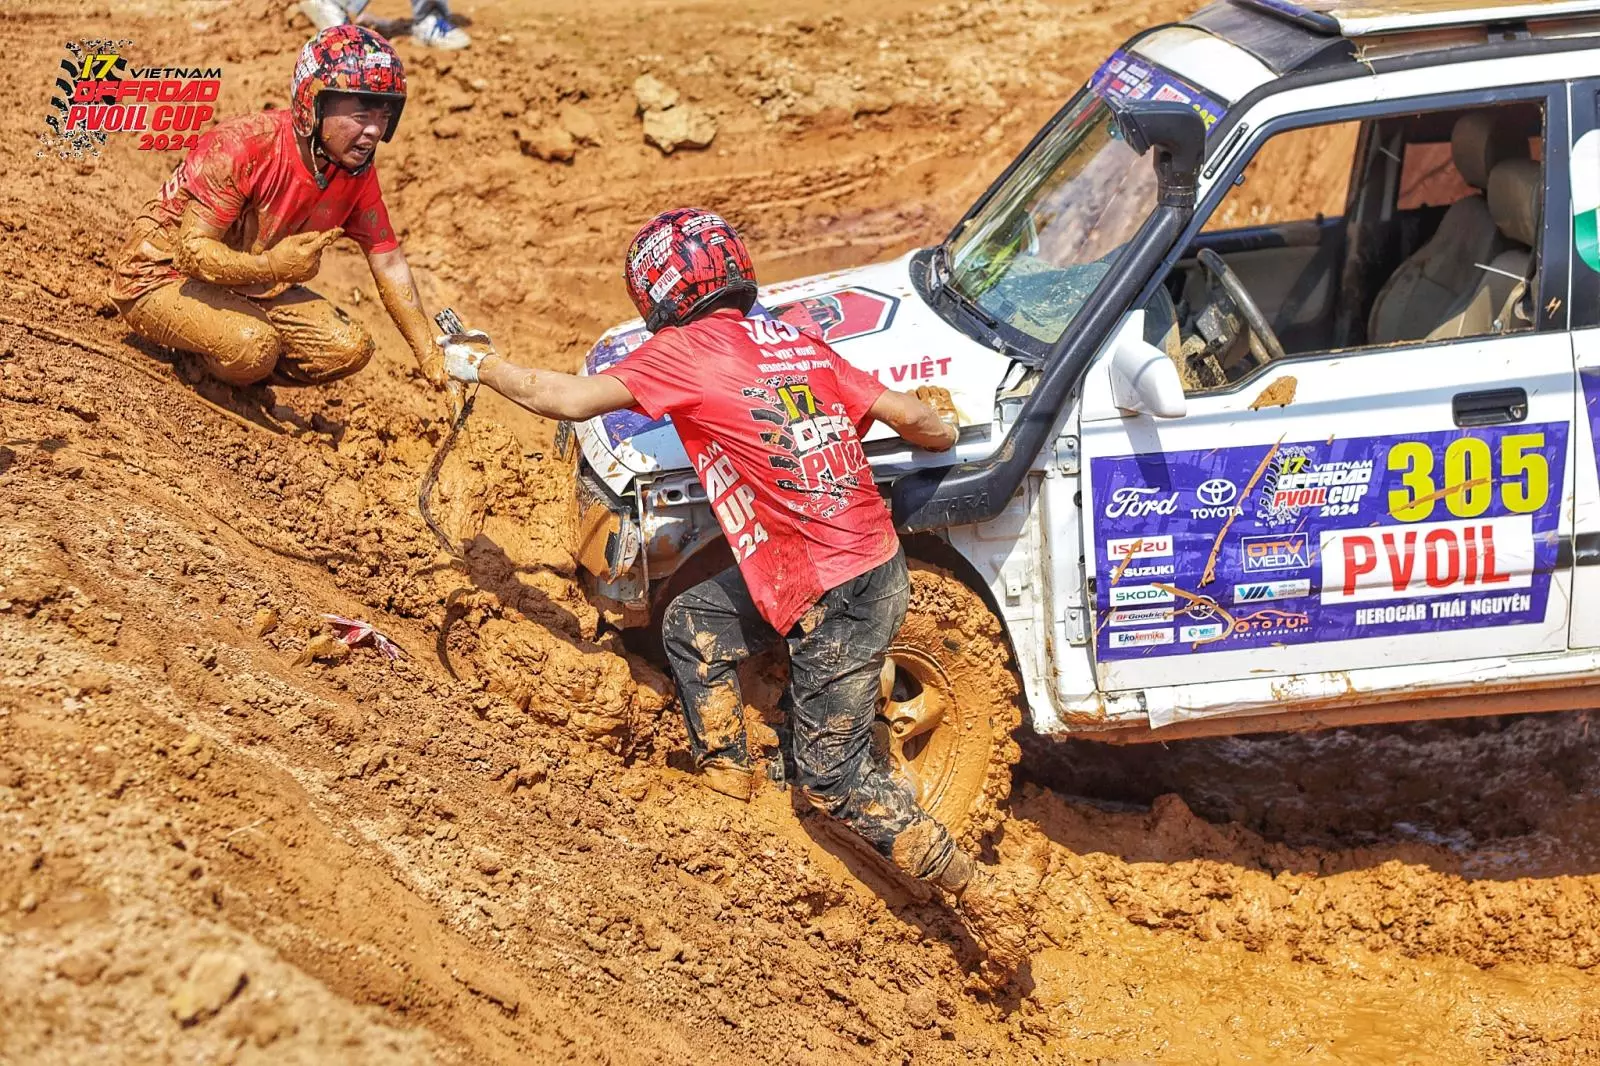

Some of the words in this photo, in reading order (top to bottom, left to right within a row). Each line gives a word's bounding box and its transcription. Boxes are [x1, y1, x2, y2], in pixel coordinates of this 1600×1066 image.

[653, 236, 673, 259] CUP
[657, 269, 679, 289] PVOIL
[890, 355, 953, 383] VIỆT
[776, 382, 816, 420] 17
[1282, 456, 1307, 475] 17
[1313, 460, 1373, 472] VIETNAM
[1277, 468, 1372, 490] OFFROAD
[1387, 432, 1549, 522] 305
[1105, 487, 1179, 518] Ford
[1273, 487, 1326, 508] PVOIL
[1328, 485, 1368, 504] CUP
[1190, 507, 1244, 519] TOYOTA
[1320, 503, 1359, 517] 2024
[1113, 542, 1167, 555] ISUZU
[1124, 565, 1174, 577] SUZUKI
[1248, 555, 1303, 569] MEDIA
[1342, 525, 1511, 596] PVOIL
[1355, 603, 1427, 626] HEROCAR
[1430, 599, 1466, 619] THÁI
[1234, 616, 1309, 633] OTOFUN
